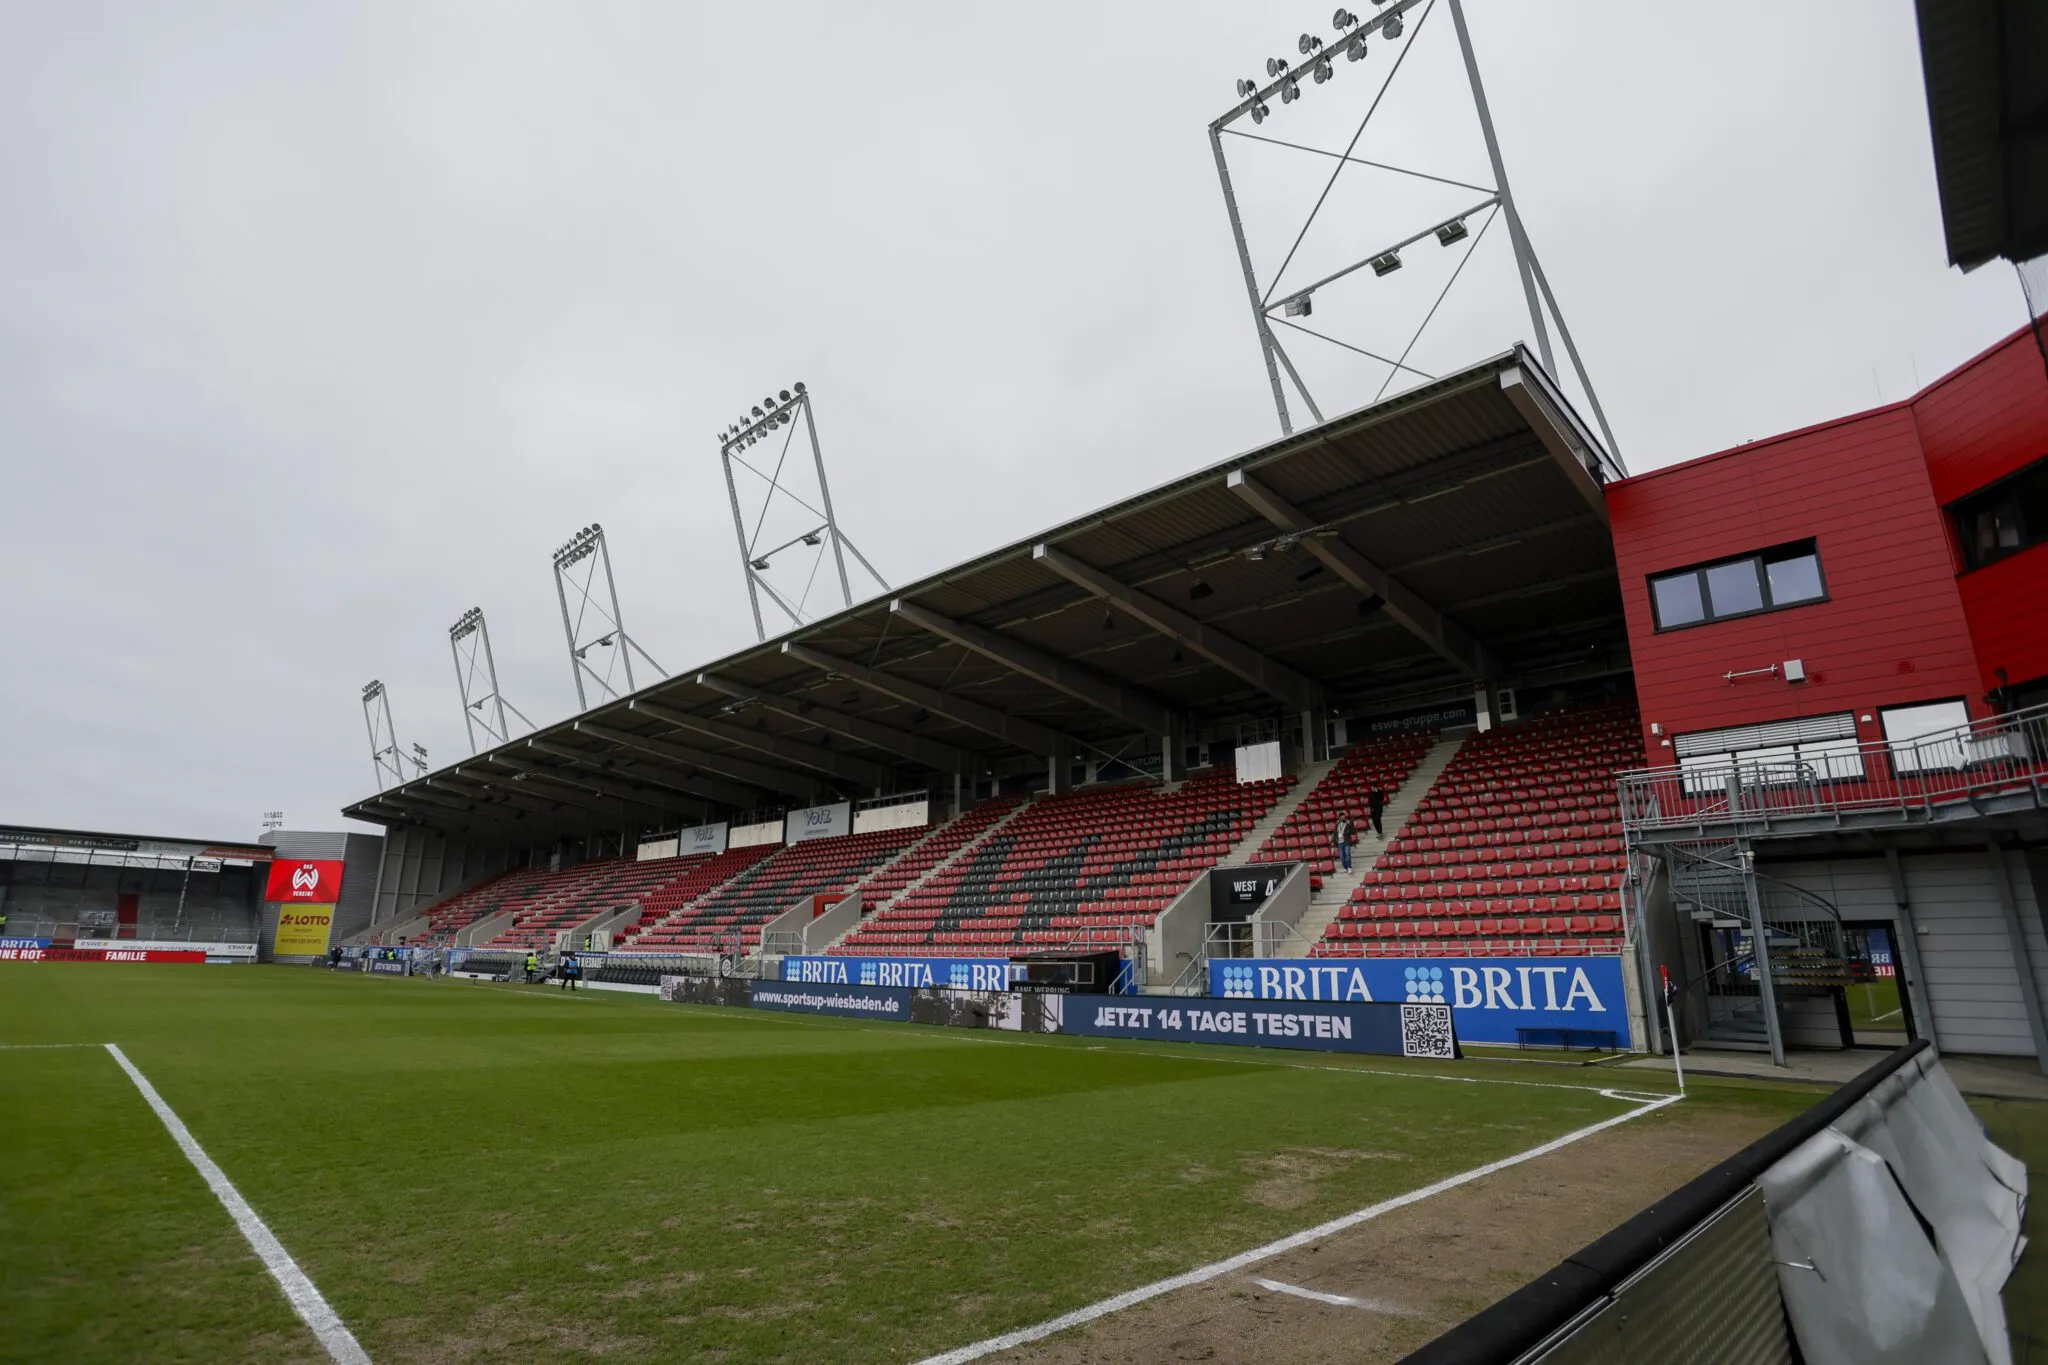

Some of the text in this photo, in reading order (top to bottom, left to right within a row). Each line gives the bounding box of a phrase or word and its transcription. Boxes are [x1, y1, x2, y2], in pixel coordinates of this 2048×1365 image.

[1233, 880, 1257, 893] WEST
[294, 915, 330, 926] LOTTO
[1, 939, 39, 949] BRITA
[105, 950, 147, 960] FAMILIE
[801, 960, 849, 984] BRITA
[878, 962, 934, 987] BRITA
[971, 964, 1028, 992] BRIT
[1258, 966, 1374, 1002] BRITA
[1450, 966, 1607, 1012] BRITA
[758, 991, 899, 1013] www.sportsup-wiesbaden.de
[1094, 1006, 1352, 1040] JETZT 14 TAGE TESTEN
